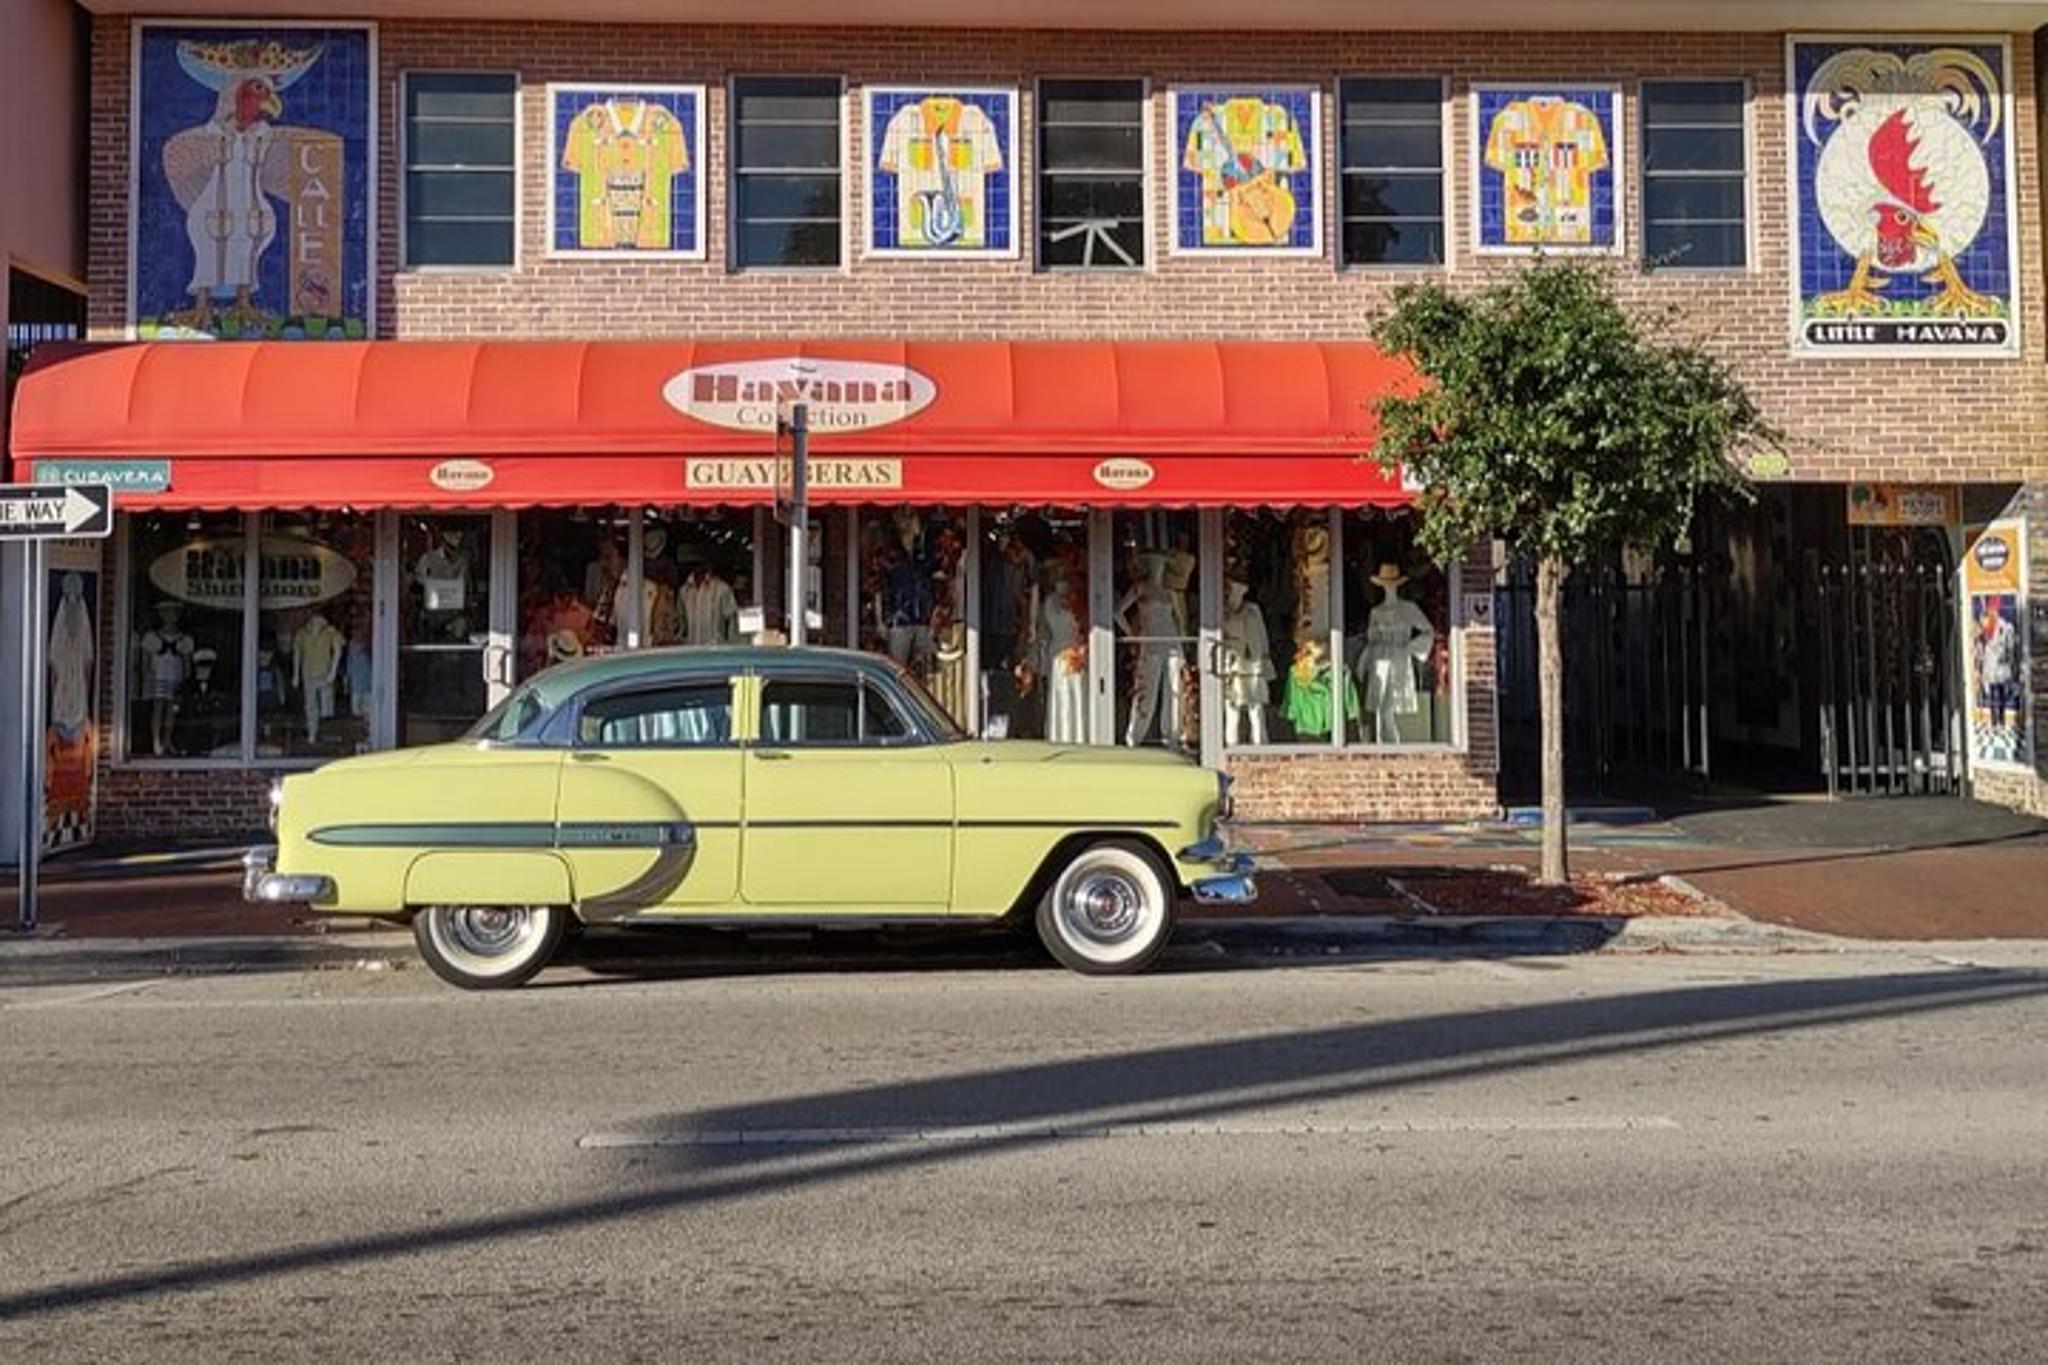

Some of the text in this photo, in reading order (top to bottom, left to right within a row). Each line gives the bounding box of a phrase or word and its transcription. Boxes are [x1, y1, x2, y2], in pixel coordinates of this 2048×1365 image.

[297, 144, 329, 263] CALLE
[1815, 326, 1998, 341] LITTLE HAVANA
[736, 405, 867, 426] Coction
[25, 502, 66, 519] WAY
